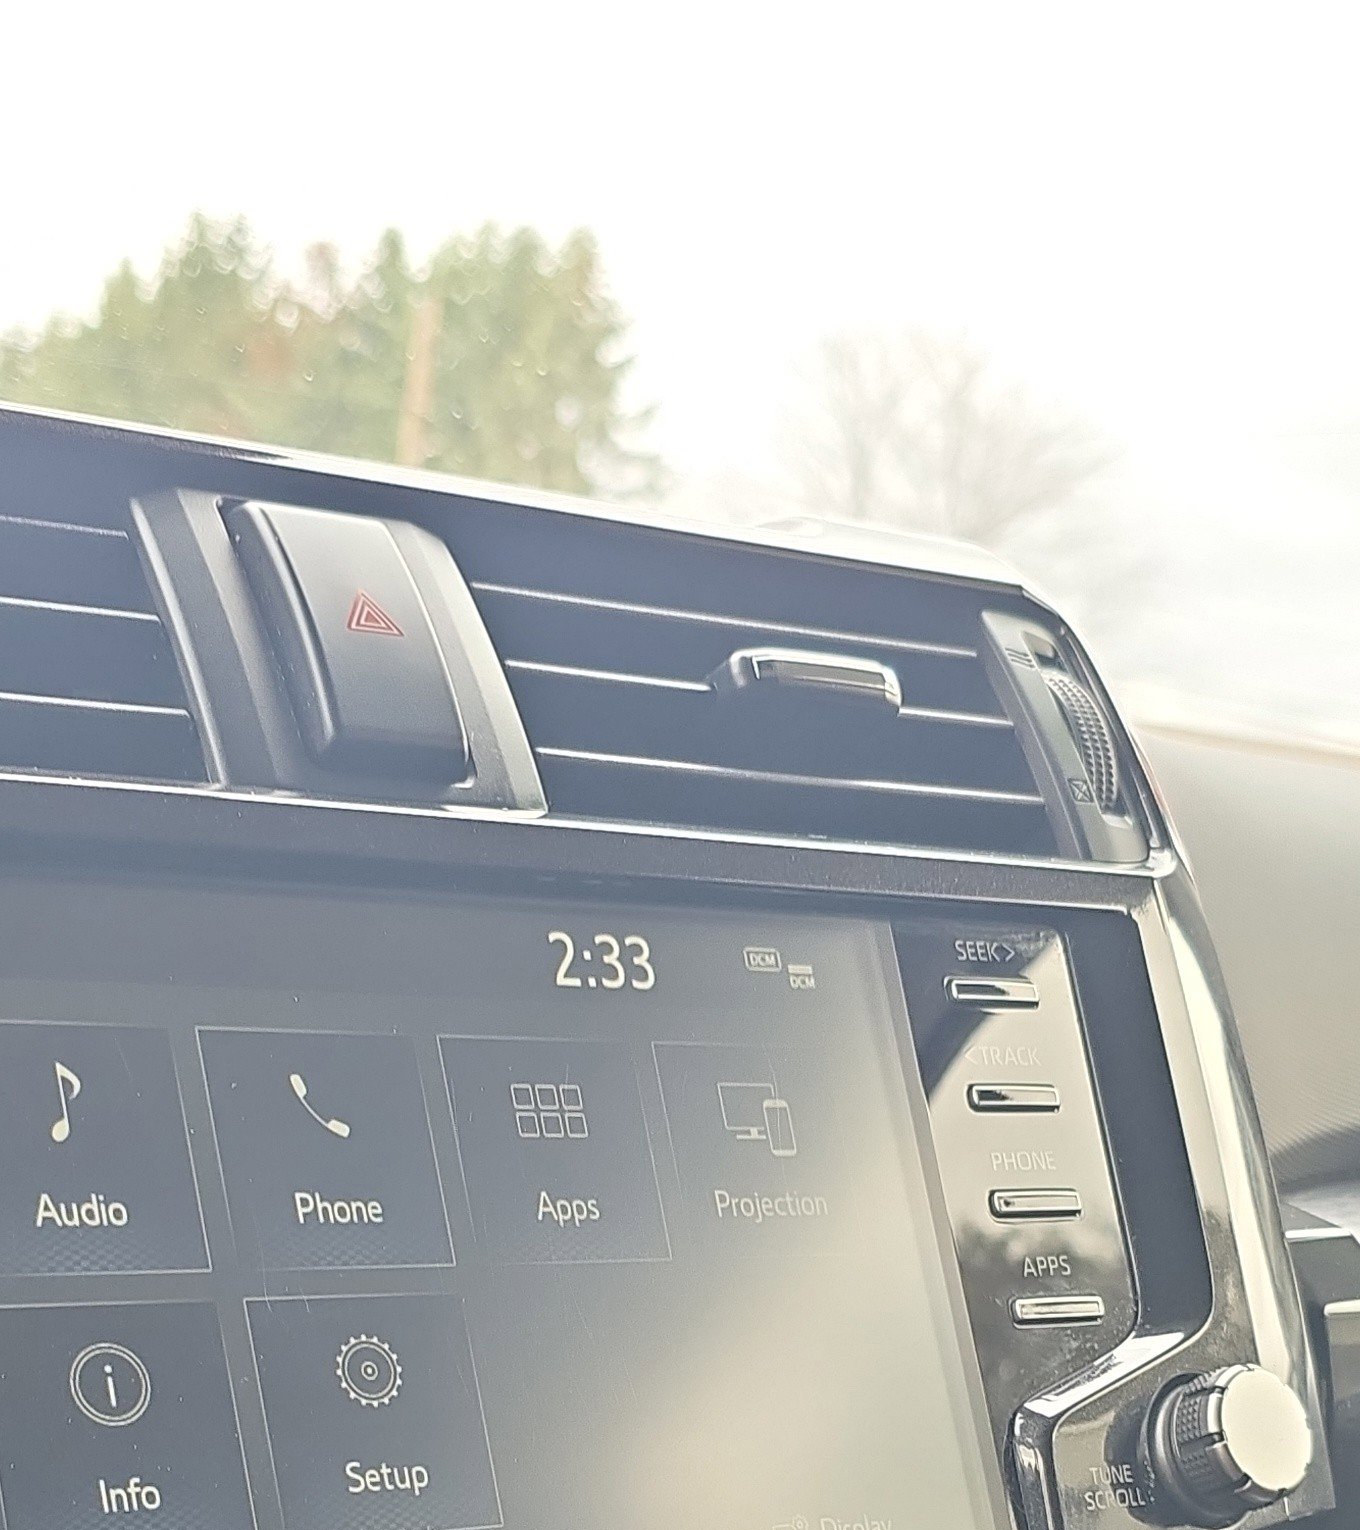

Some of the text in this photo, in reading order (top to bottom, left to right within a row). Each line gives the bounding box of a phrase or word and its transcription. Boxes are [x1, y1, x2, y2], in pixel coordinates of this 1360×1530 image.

[547, 931, 657, 991] 2:33
[749, 952, 776, 967] DCM
[990, 1151, 1057, 1172] PHONE
[36, 1194, 128, 1227] Audio
[295, 1192, 383, 1225] Phone
[537, 1191, 600, 1224] Apps
[714, 1189, 828, 1220] Projection
[1023, 1255, 1071, 1278] APPS
[345, 1460, 429, 1496] Setup
[1090, 1464, 1134, 1485] TUNE
[99, 1478, 161, 1514] Info
[1084, 1488, 1146, 1511] SCROLL
